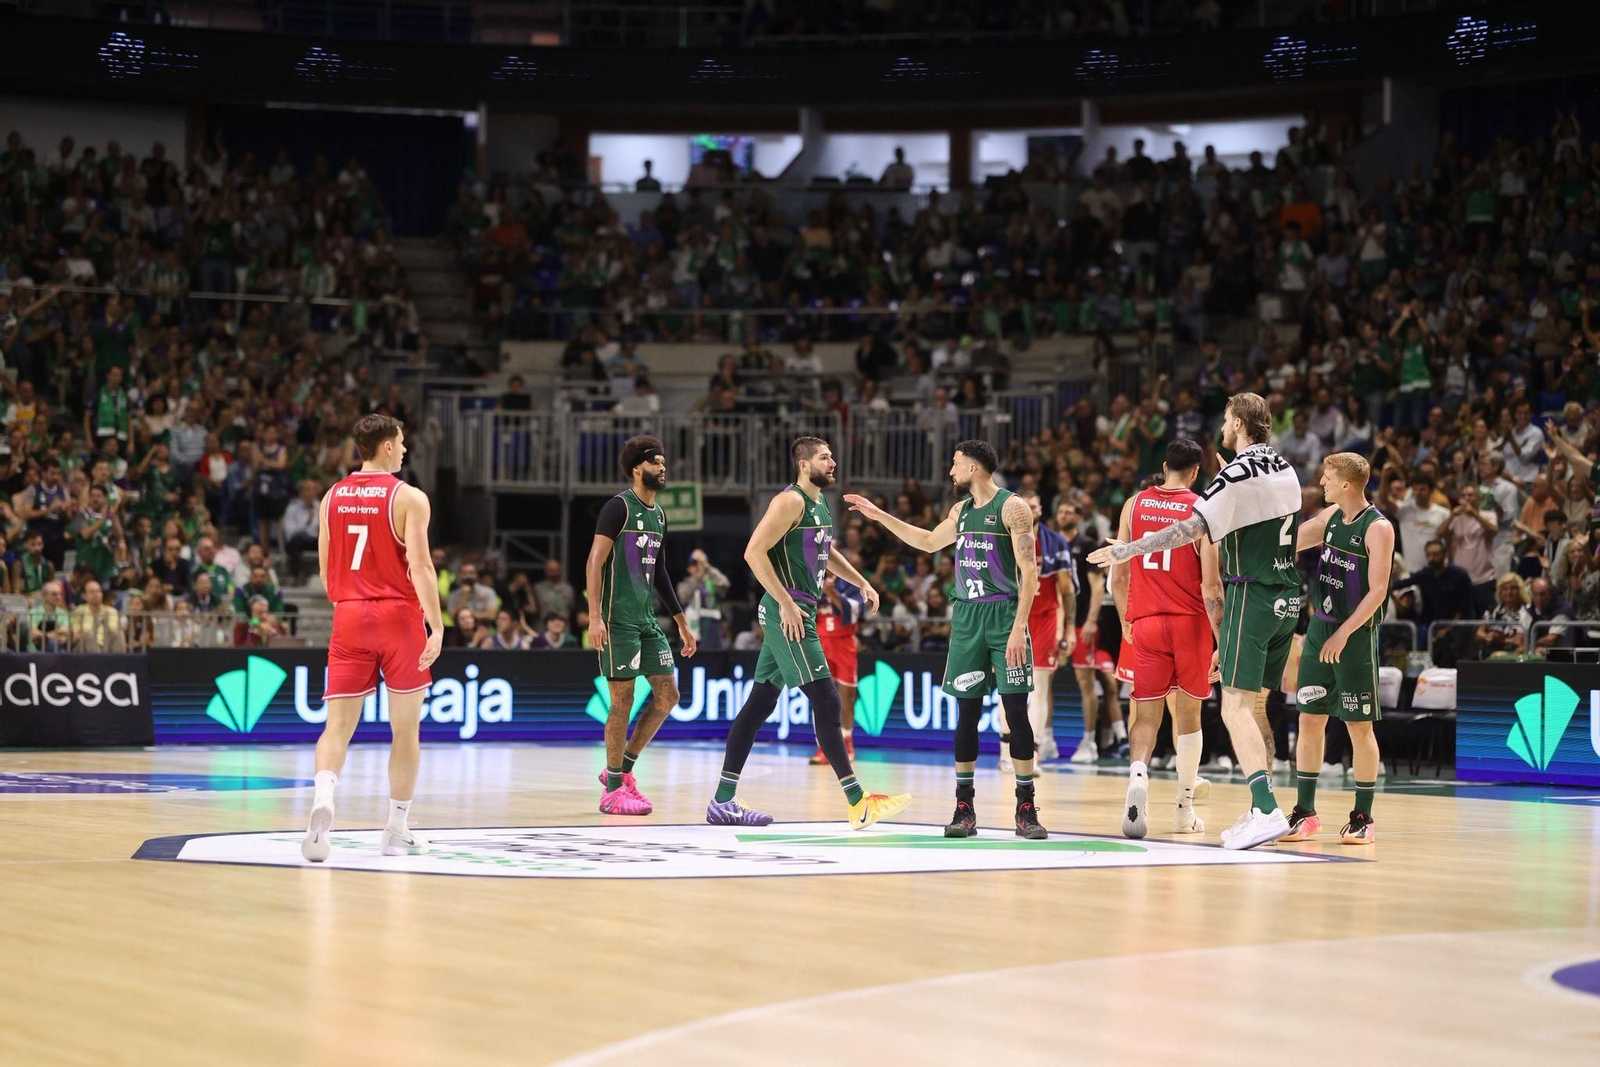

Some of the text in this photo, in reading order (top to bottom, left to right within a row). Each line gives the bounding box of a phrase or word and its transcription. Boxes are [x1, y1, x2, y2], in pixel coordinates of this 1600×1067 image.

[336, 486, 388, 498] HOLLANDERS
[338, 505, 379, 515] Kave Home
[1140, 498, 1188, 512] FERNÁNDEZ
[1140, 513, 1157, 522] Kave
[348, 524, 368, 570] 7
[964, 540, 993, 551] Unicaja
[1330, 554, 1355, 571] Unicaja
[0, 662, 139, 707] desa
[294, 664, 513, 740] Uiaja
[1342, 701, 1359, 712] laga
